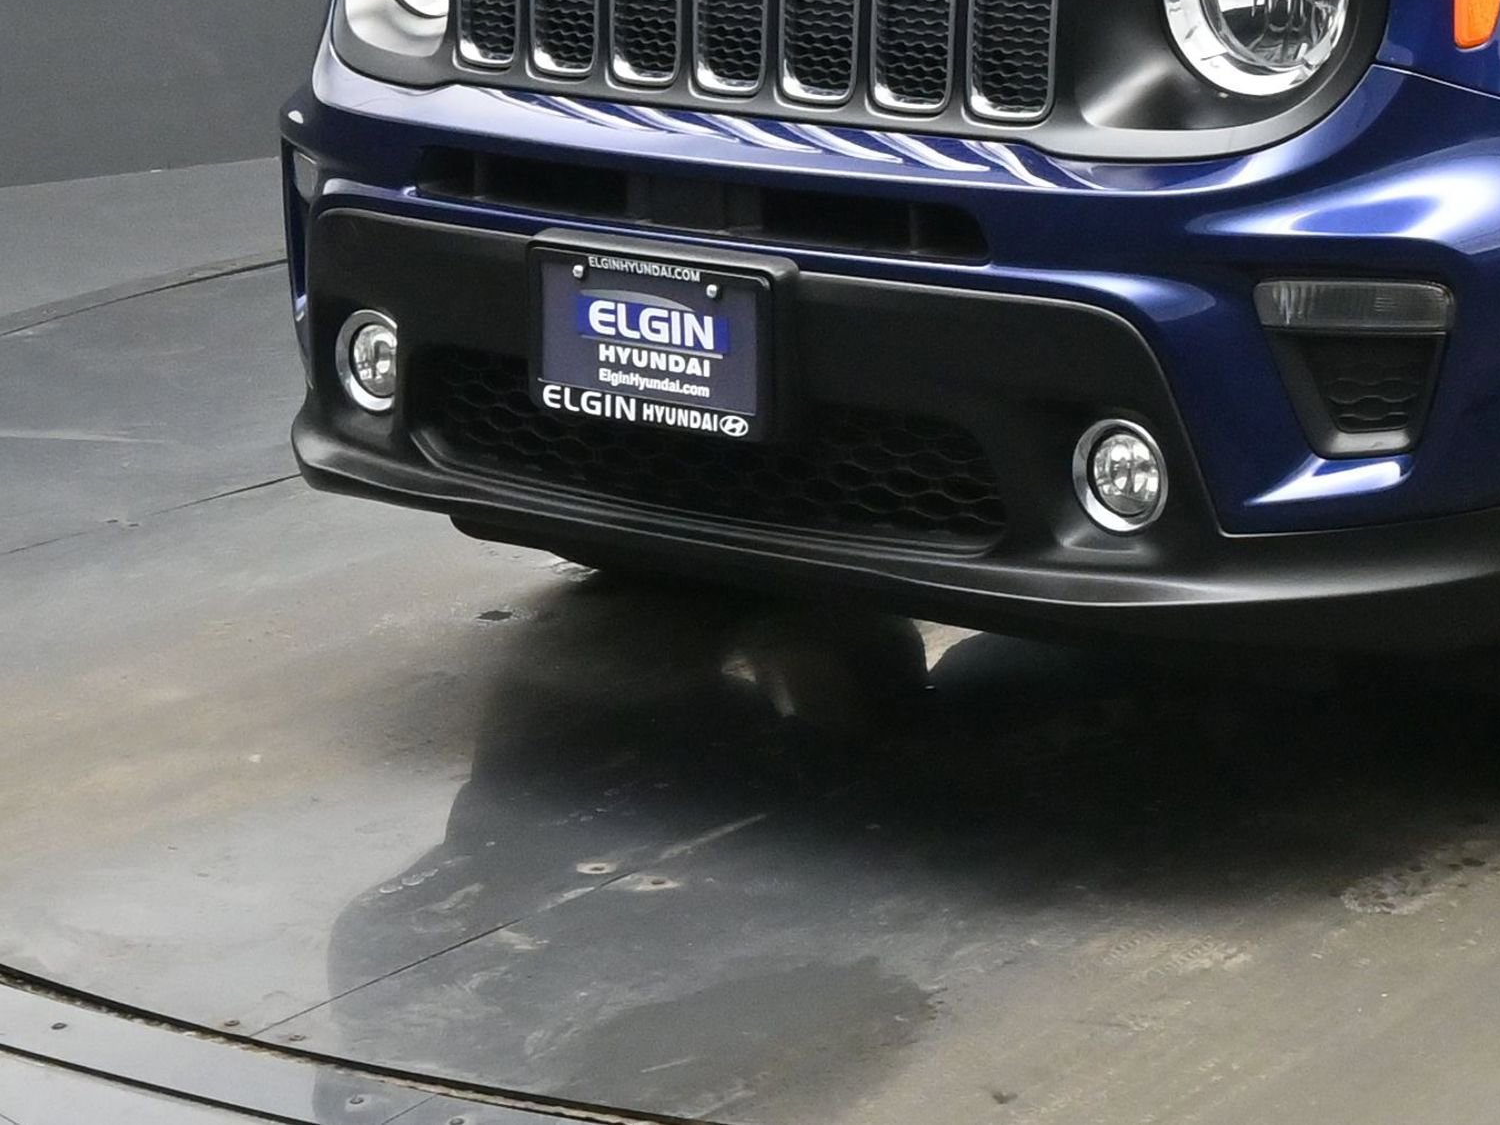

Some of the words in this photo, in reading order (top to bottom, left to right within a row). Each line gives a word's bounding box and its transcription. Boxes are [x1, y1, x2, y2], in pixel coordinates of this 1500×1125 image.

[588, 256, 701, 282] ELGINHYUNDAI.COM
[588, 300, 715, 350] ELGIN
[599, 344, 711, 377] HYUNDAI
[599, 368, 710, 397] ElginHyundai.com
[542, 385, 636, 421] ELGIN
[642, 403, 718, 432] HYUNDAI
